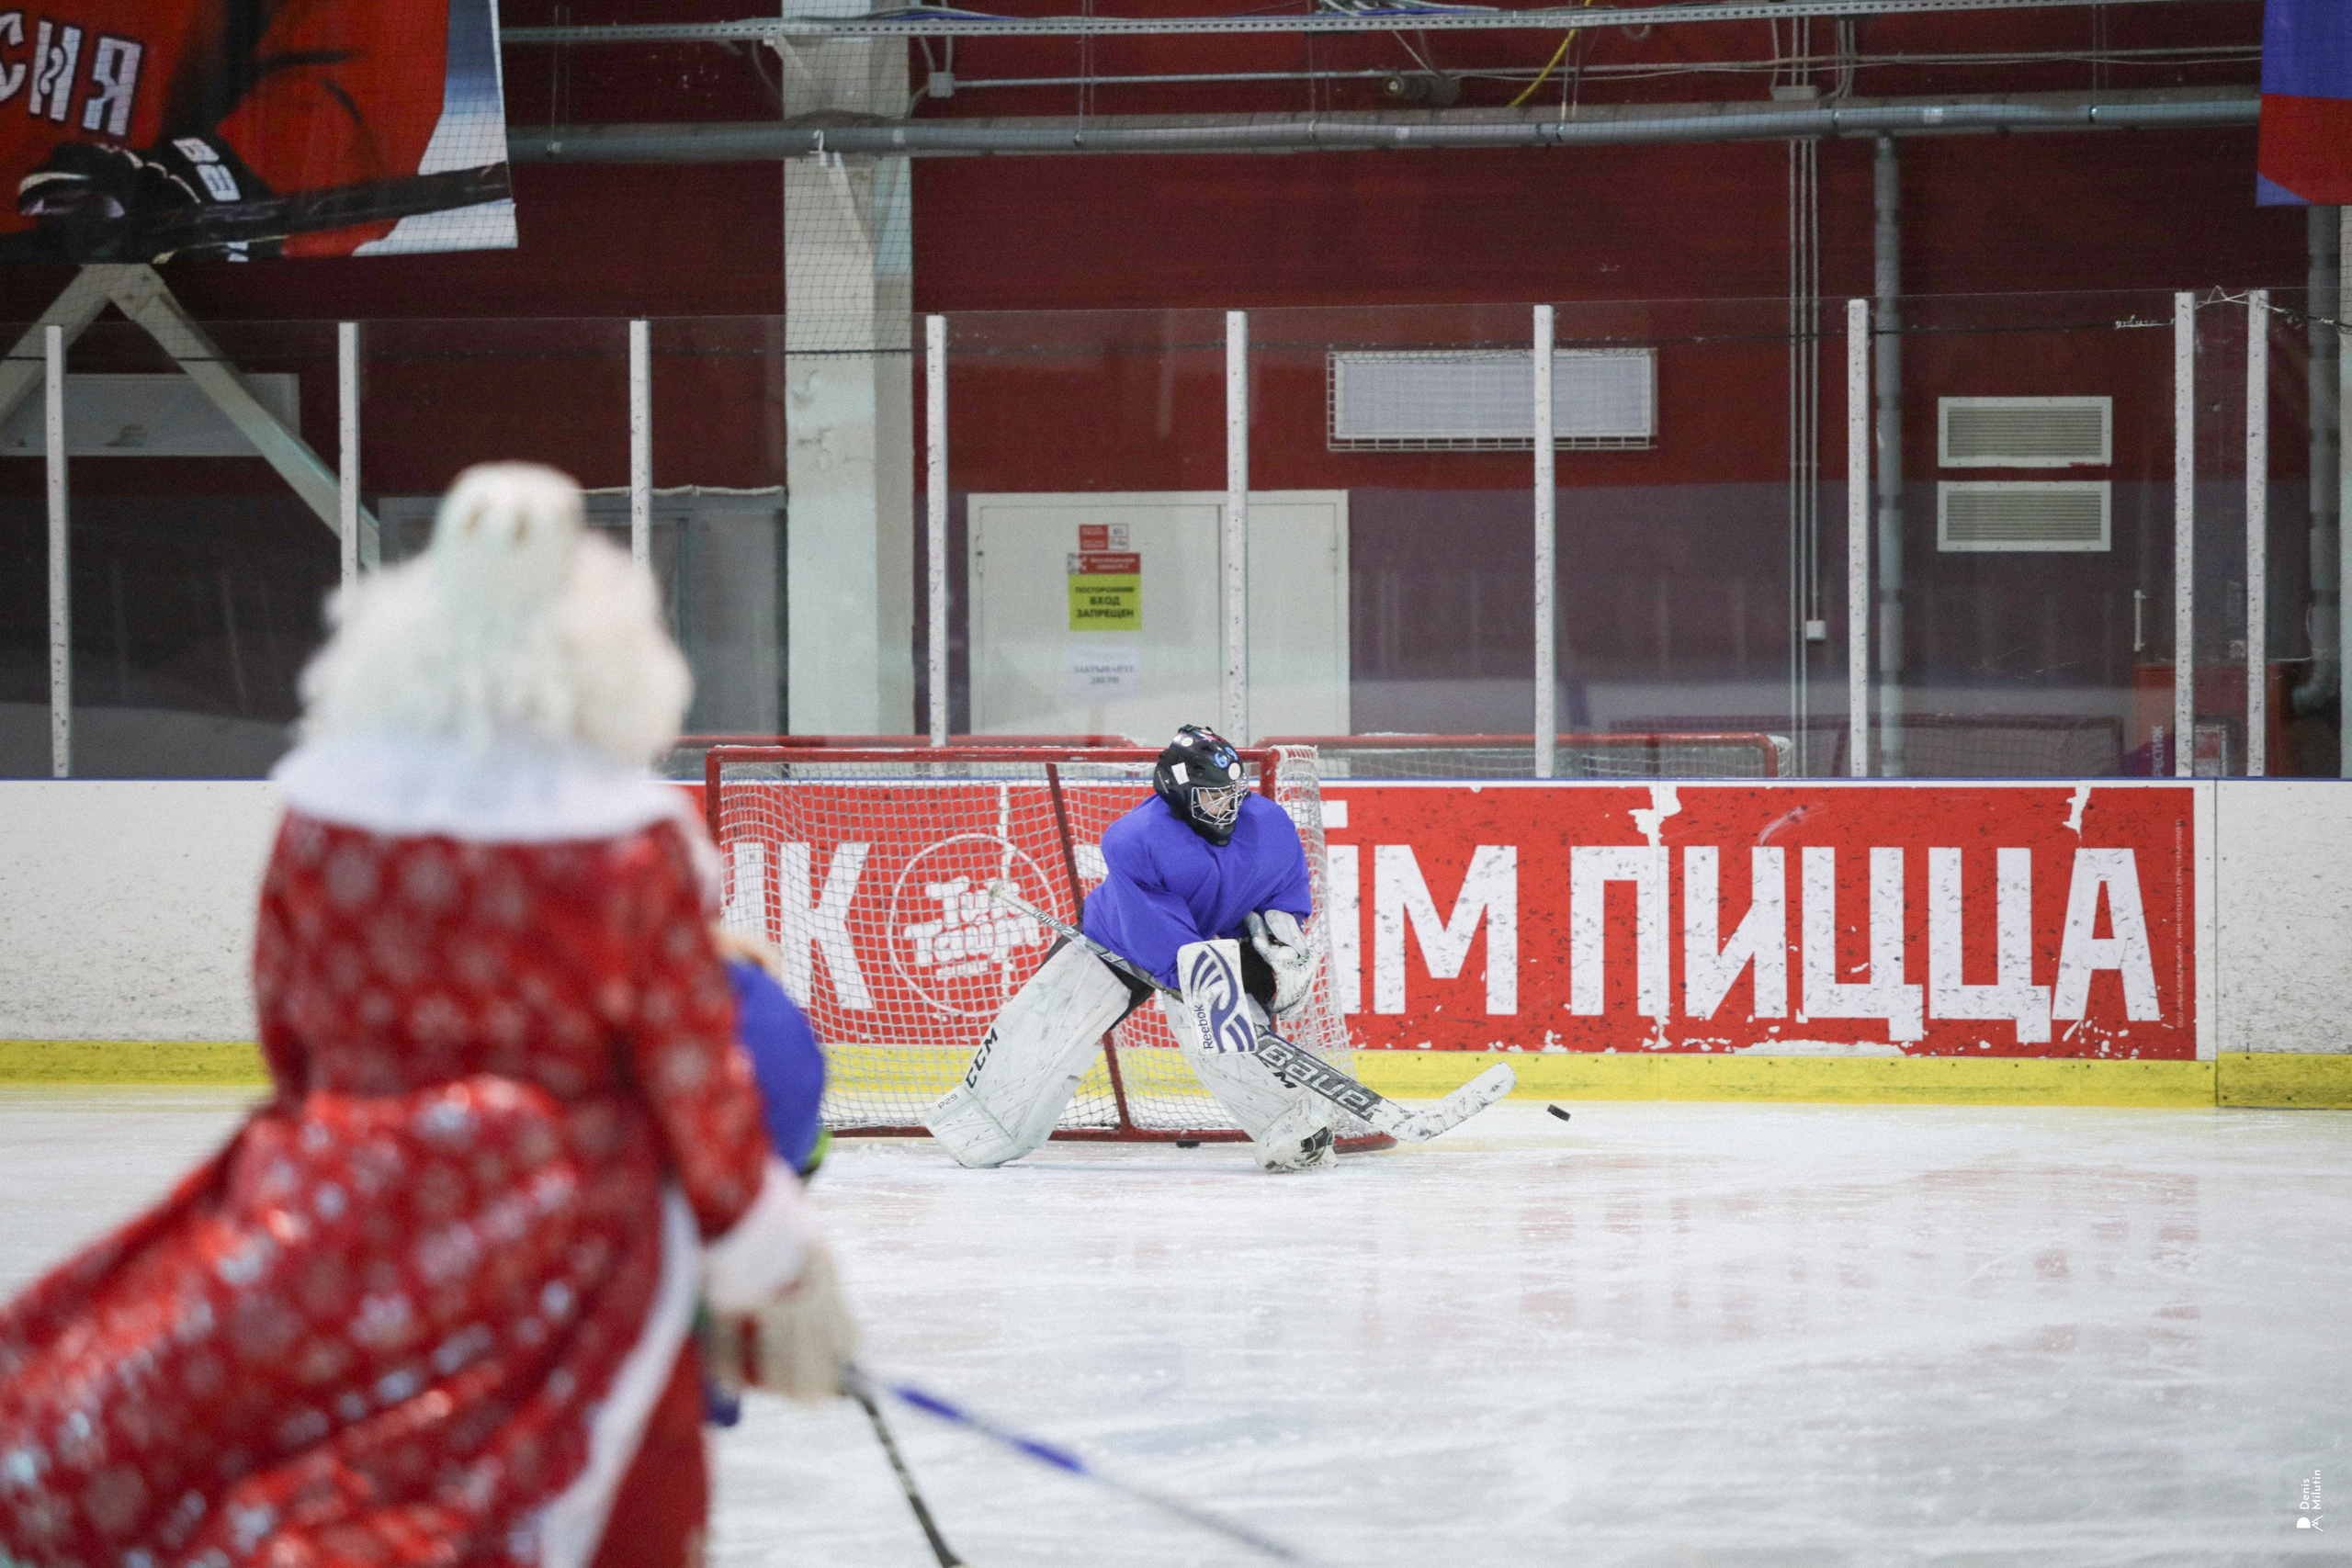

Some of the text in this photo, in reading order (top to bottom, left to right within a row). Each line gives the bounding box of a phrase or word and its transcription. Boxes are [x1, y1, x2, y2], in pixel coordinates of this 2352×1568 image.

[1077, 608, 1134, 619] ЗАПРЕЩЕН
[1089, 596, 1121, 605] ВХОД
[1569, 845, 2162, 1043] ПИЦЦА
[1195, 1003, 1215, 1050] Reebok
[965, 1027, 999, 1089] CCM
